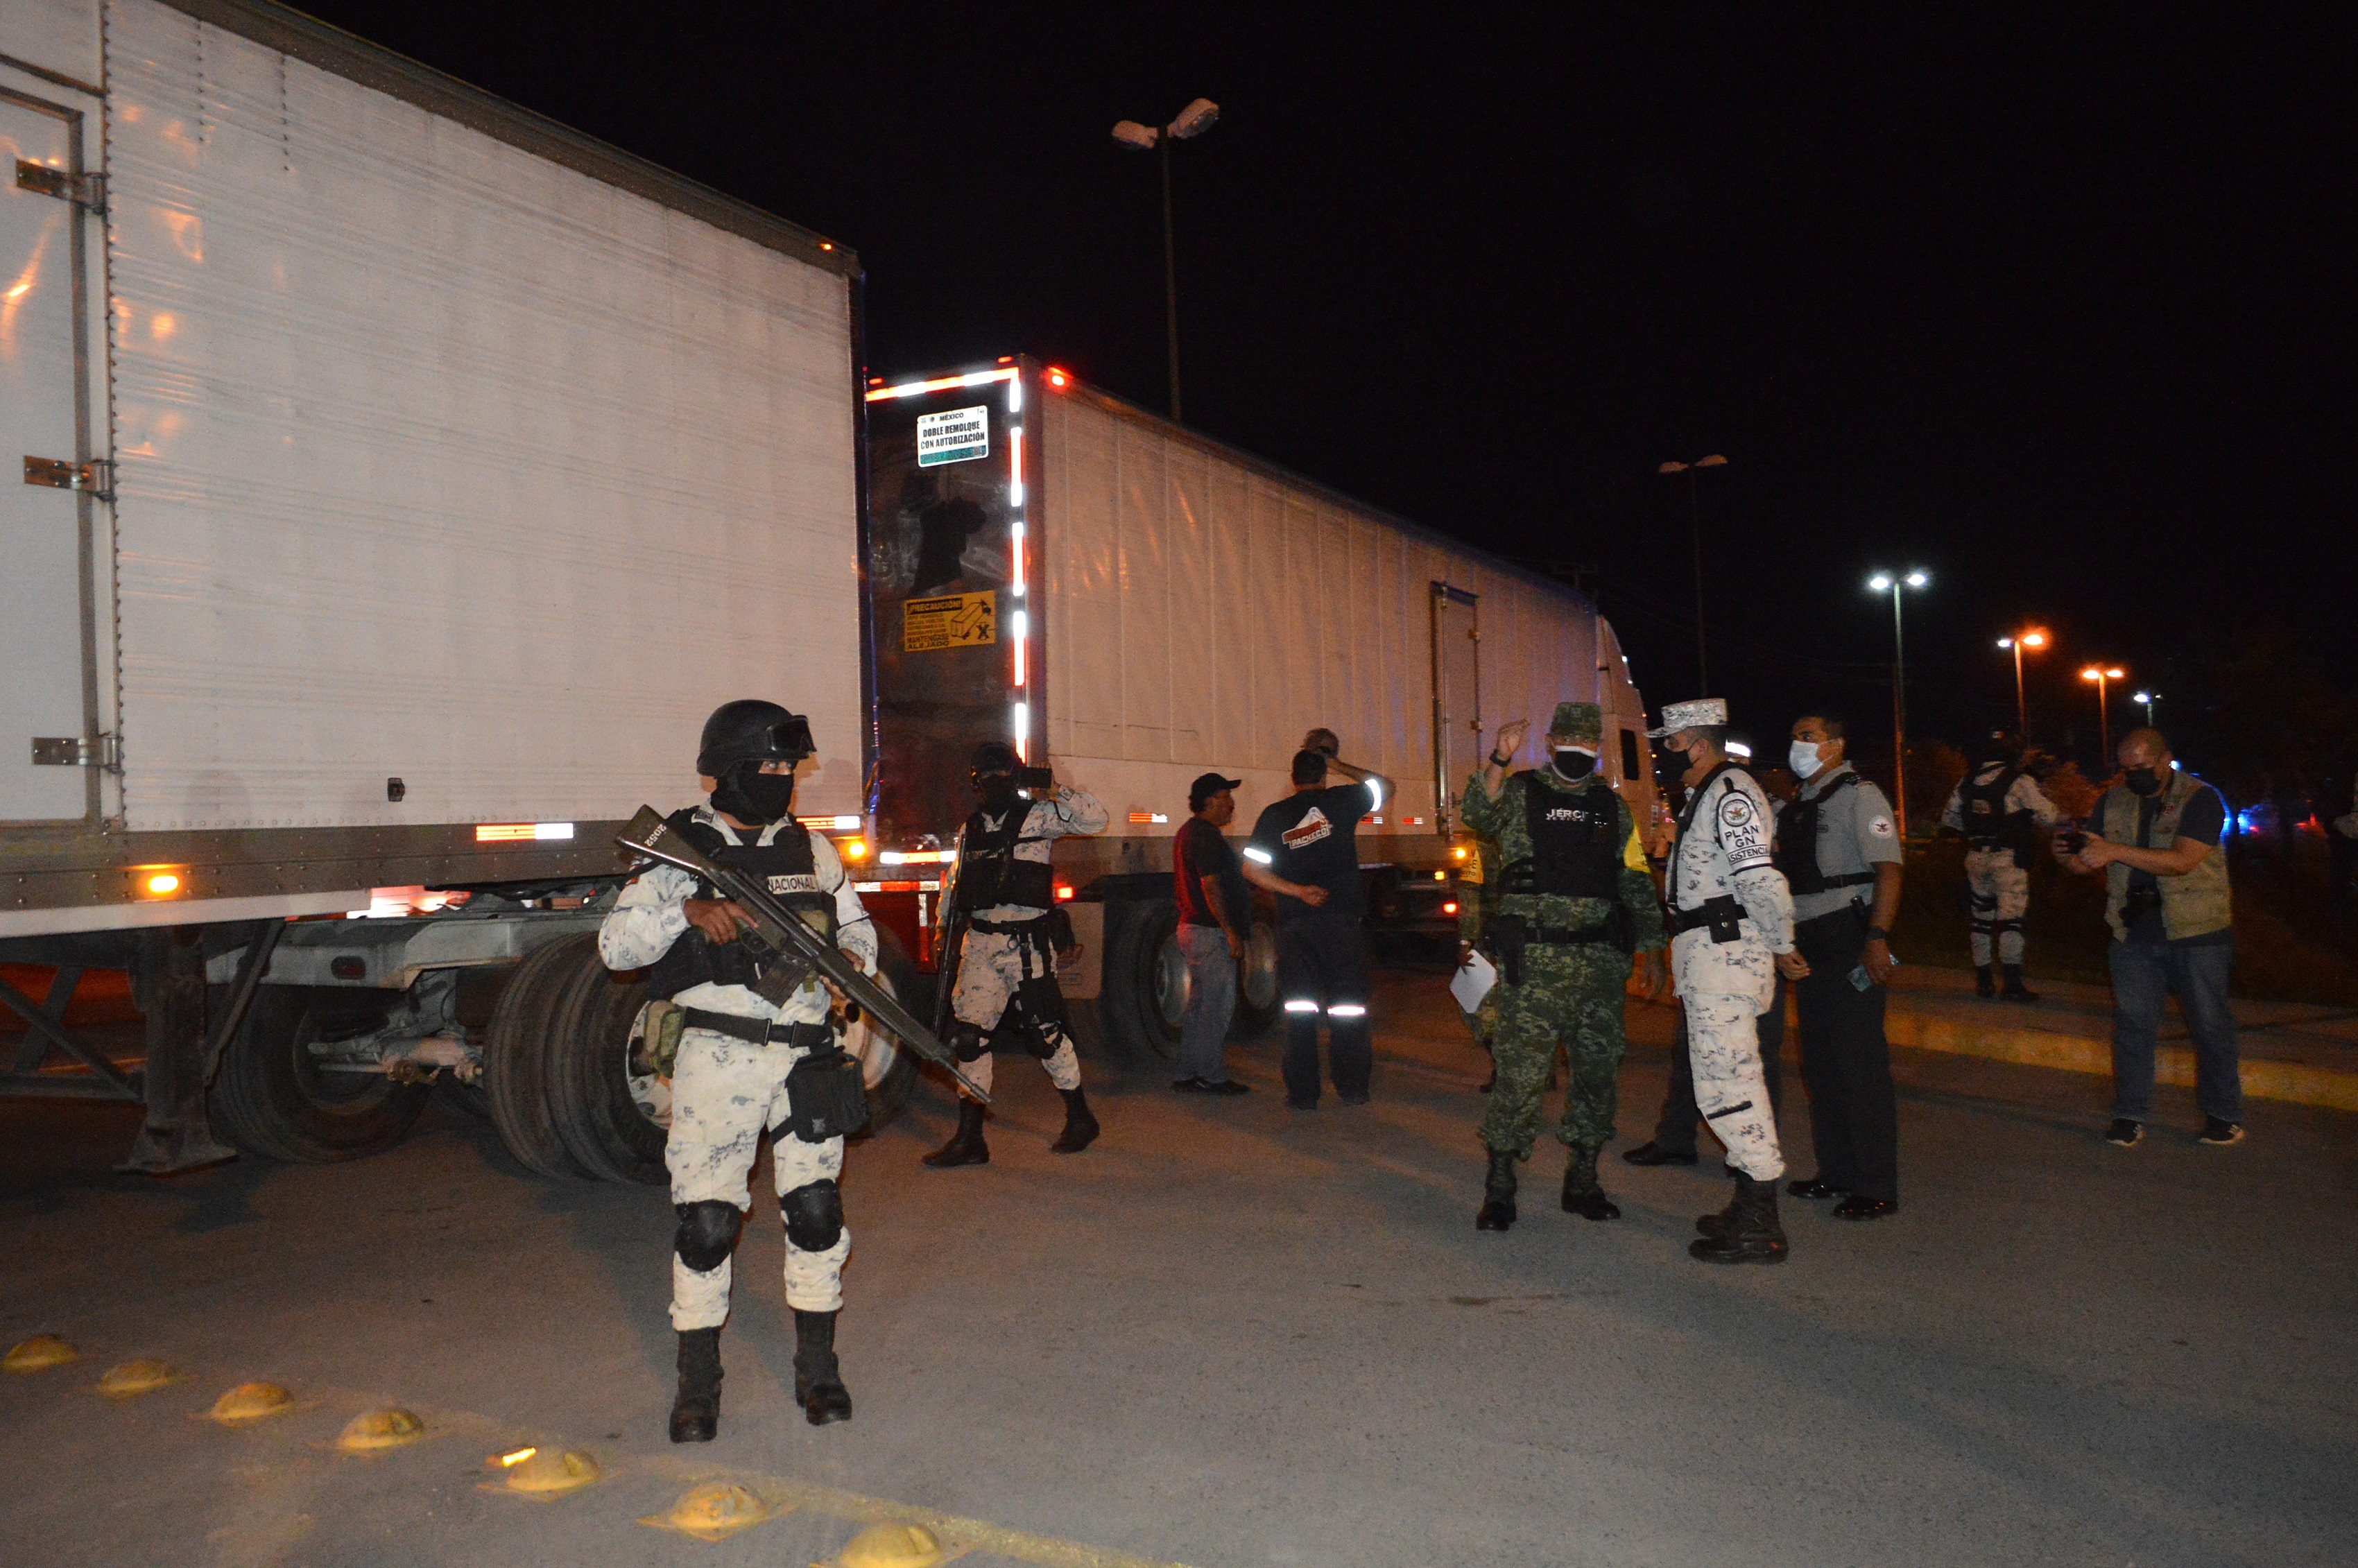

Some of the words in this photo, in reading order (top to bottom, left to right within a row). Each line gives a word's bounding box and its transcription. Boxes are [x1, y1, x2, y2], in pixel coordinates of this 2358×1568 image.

[939, 412, 964, 422] MÉXICO
[922, 427, 944, 438] DOBLE
[945, 421, 980, 434] REMOLQUE
[920, 440, 934, 449] CON
[936, 431, 985, 447] AUTORIZACIÓN
[1291, 826, 1327, 847] PACHECO
[1724, 825, 1759, 841] PLAN
[1735, 835, 1756, 847] GN
